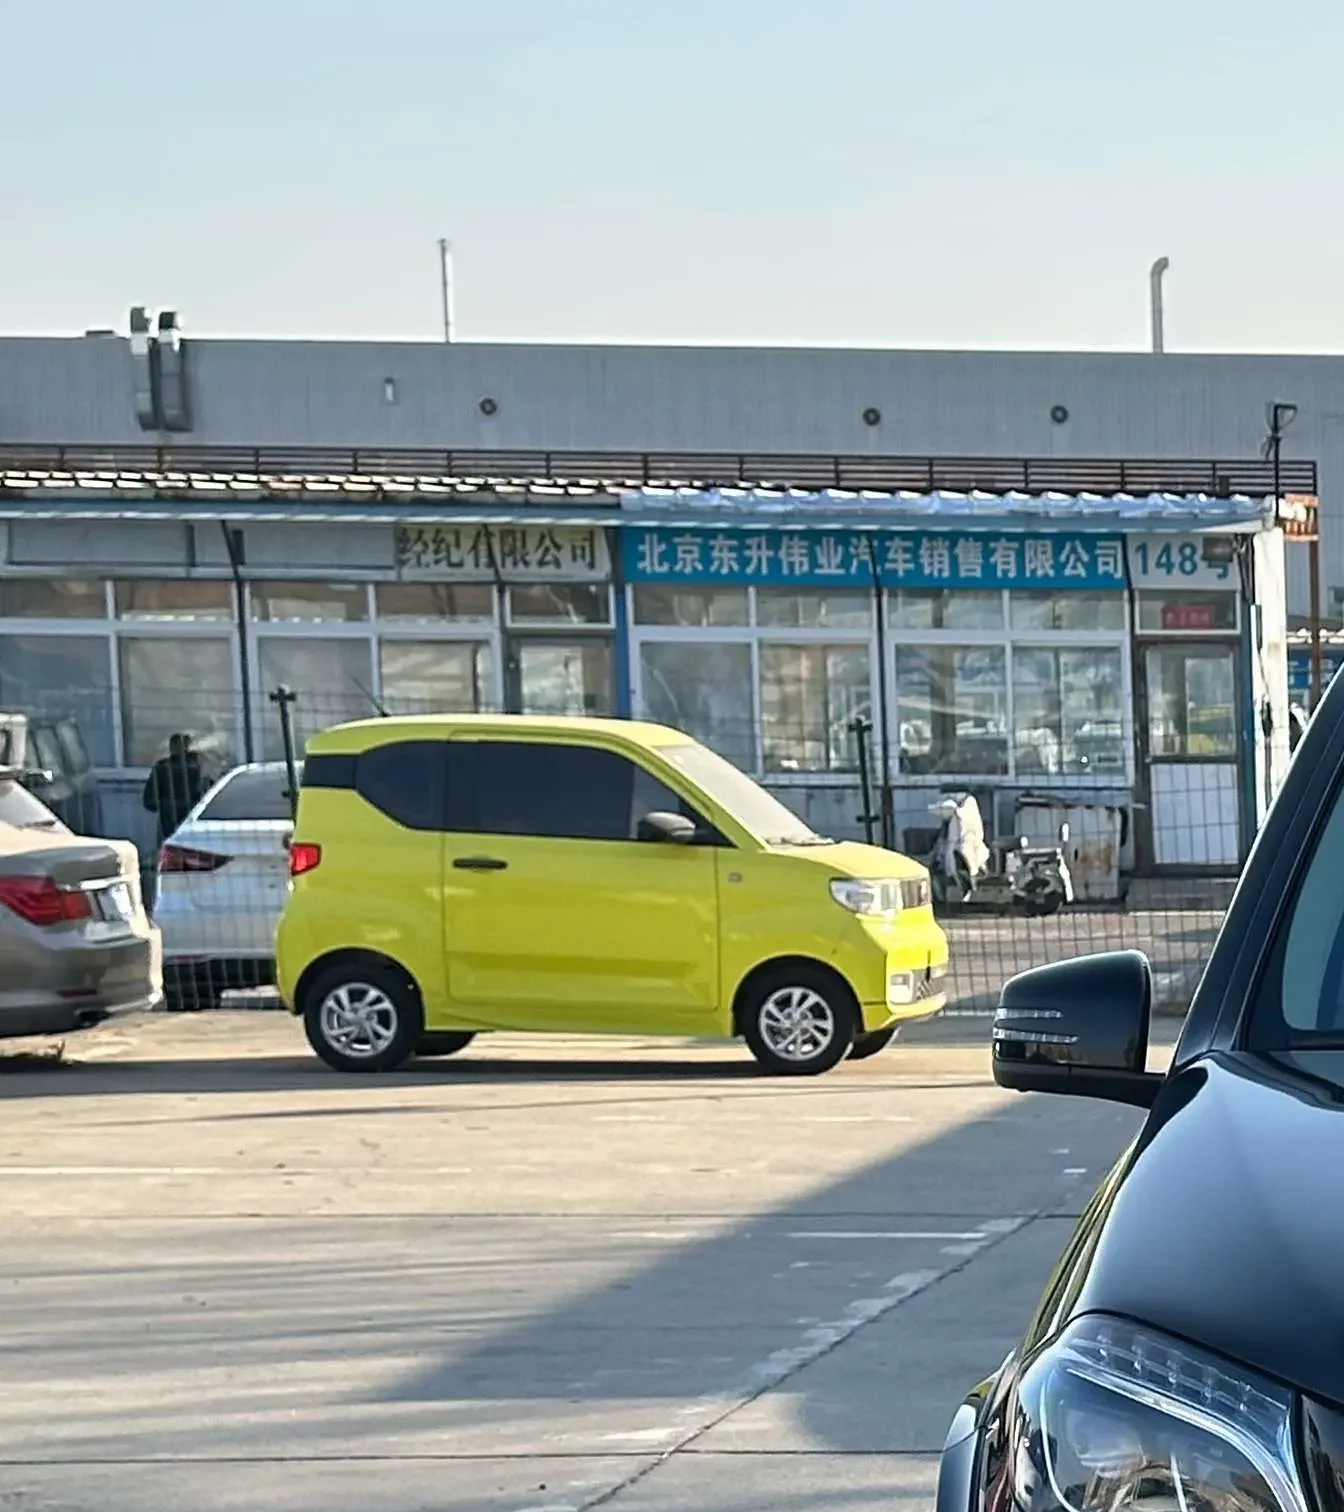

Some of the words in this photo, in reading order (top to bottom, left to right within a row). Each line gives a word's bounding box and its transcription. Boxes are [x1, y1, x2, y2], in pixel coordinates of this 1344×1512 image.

[398, 527, 595, 569] 经纪有限公司
[637, 533, 1123, 578] 北京东升伟业汽车销售有限公司
